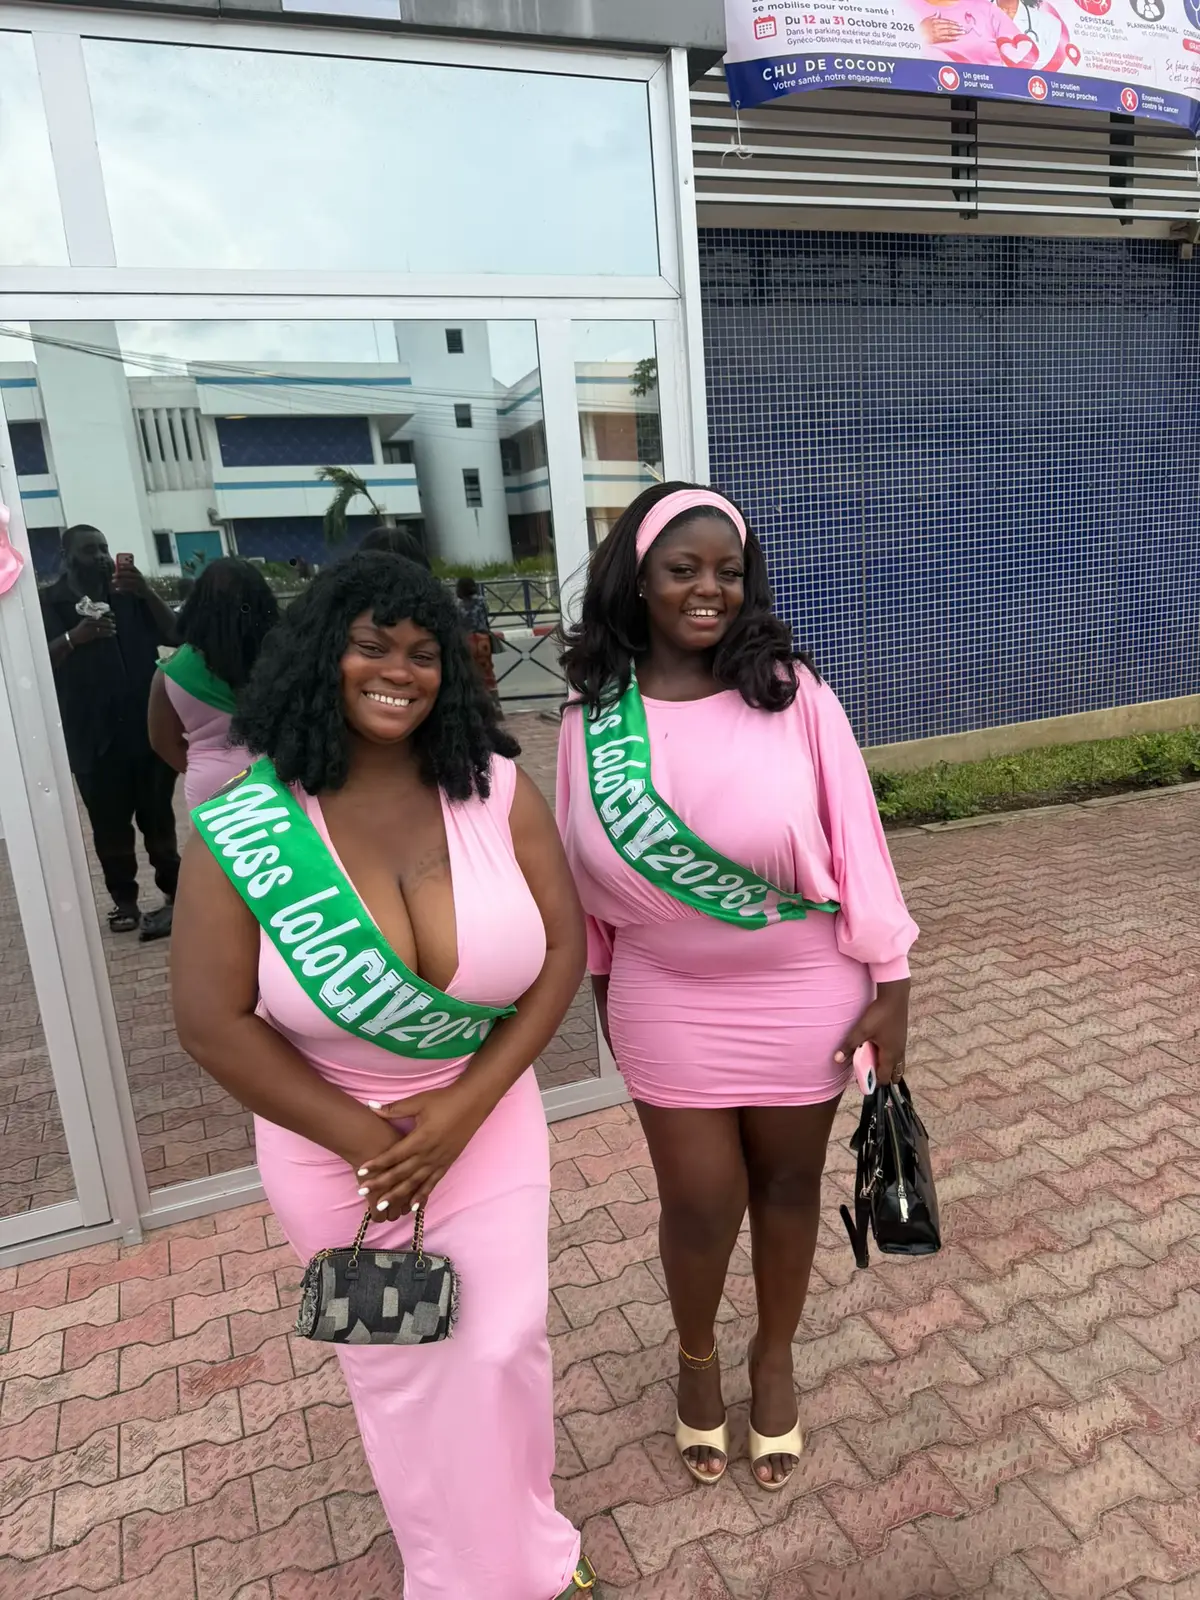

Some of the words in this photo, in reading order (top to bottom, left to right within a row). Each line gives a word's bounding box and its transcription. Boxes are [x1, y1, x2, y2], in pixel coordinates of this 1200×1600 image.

[752, 5, 764, 13] se
[767, 2, 811, 11] mobilise
[838, 4, 863, 12] votre
[865, 7, 889, 15] santé
[785, 16, 800, 25] Du
[802, 15, 816, 24] 12
[820, 17, 830, 25] au
[832, 16, 845, 25] 31
[847, 17, 888, 29] Octobre
[890, 21, 915, 32] 2026
[786, 28, 805, 36] Dans
[806, 27, 813, 35] le
[814, 27, 841, 36] parking
[842, 28, 871, 37] extérieur
[762, 62, 797, 81] CHU
[805, 59, 827, 72] DE
[834, 58, 896, 75] COCODY
[773, 79, 796, 91] Votre
[798, 73, 823, 86] santé,
[824, 73, 847, 81] notre
[847, 73, 892, 84] engagement
[972, 72, 990, 81] geste
[964, 80, 979, 88] pour
[980, 82, 994, 90] vous
[1051, 81, 1060, 89] Un
[1060, 83, 1081, 91] soutien
[1051, 90, 1065, 98] pour
[1076, 93, 1098, 102] proches
[1142, 93, 1165, 104] Ensemble
[1142, 102, 1157, 111] contre
[1158, 103, 1163, 111] le
[1164, 106, 1179, 114] cancer
[199, 783, 293, 899] Miss
[642, 845, 768, 910] 2026
